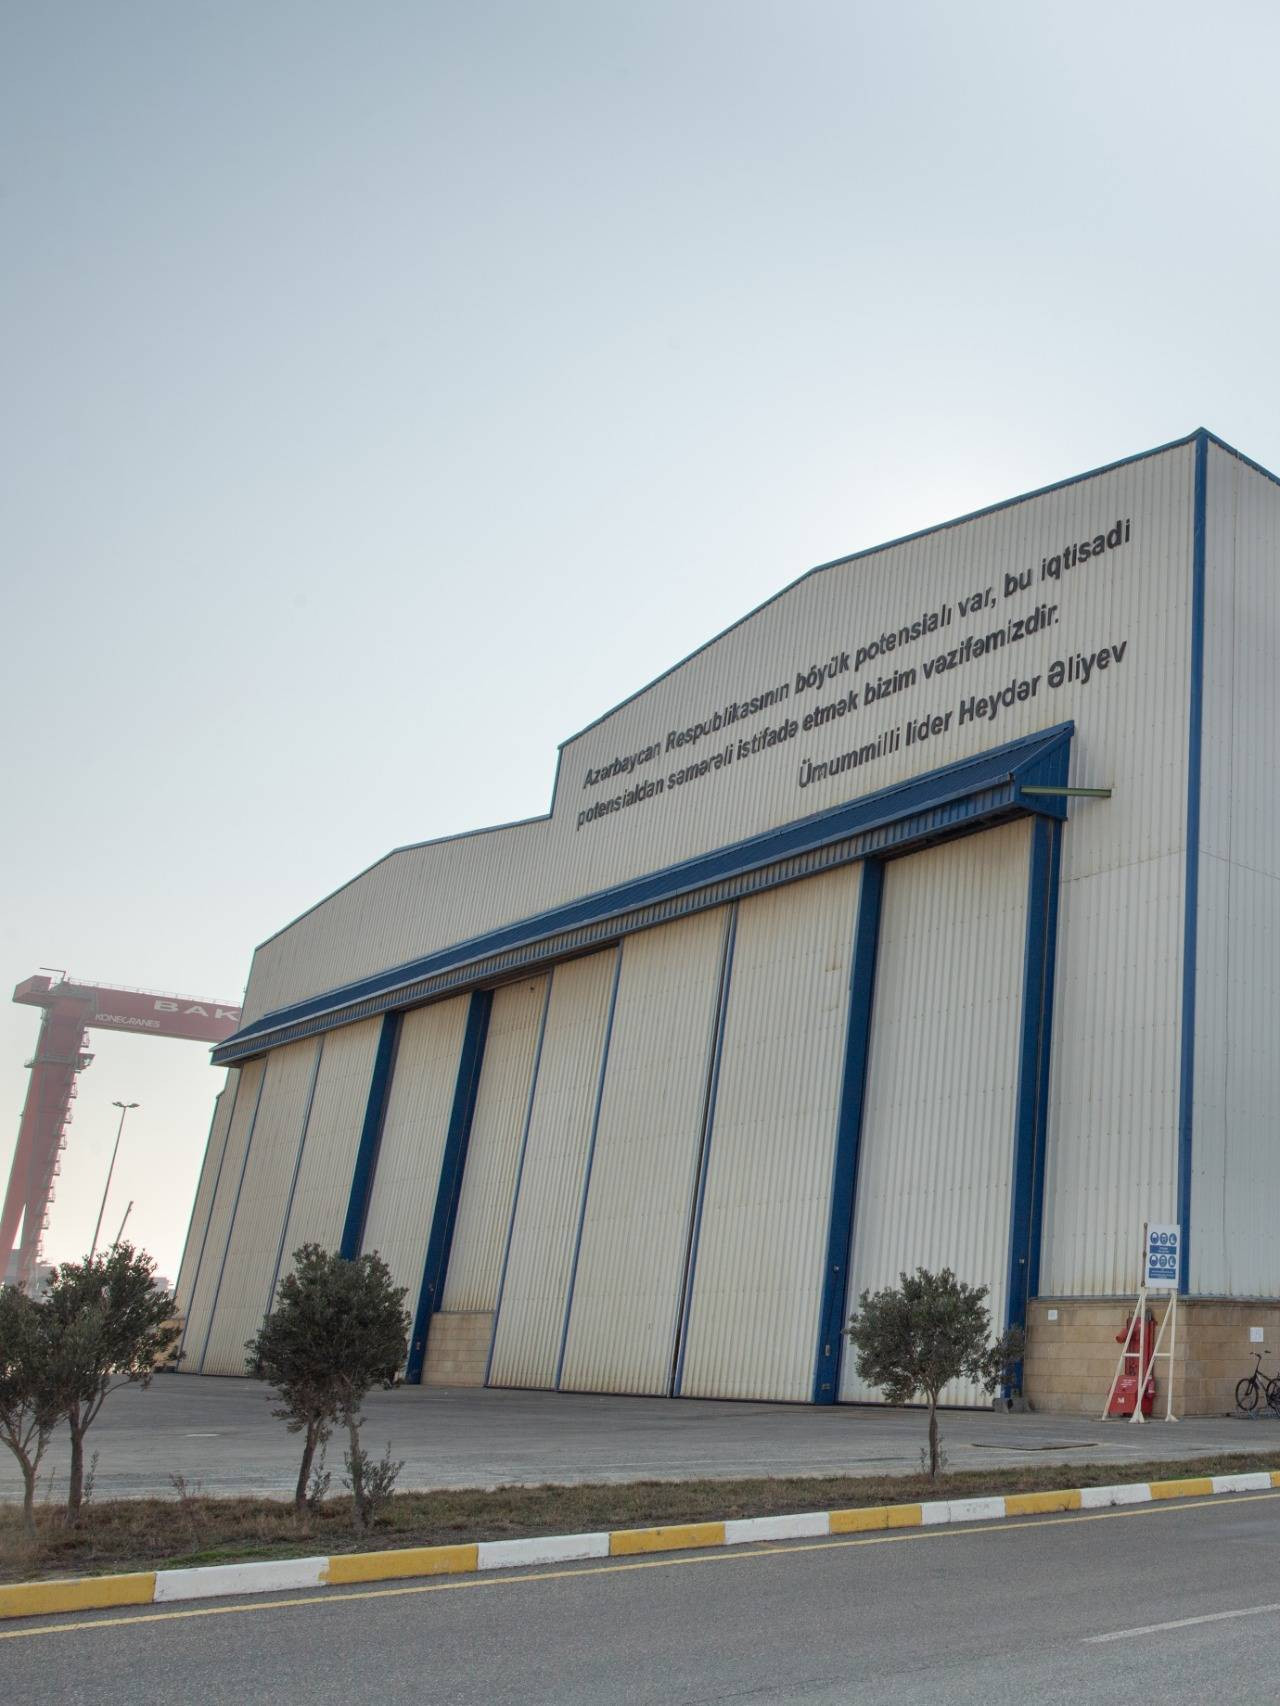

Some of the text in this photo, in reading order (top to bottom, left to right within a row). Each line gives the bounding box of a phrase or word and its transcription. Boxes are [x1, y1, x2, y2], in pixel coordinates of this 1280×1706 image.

[795, 652, 851, 695] böyük
[854, 604, 952, 672] potensialı
[957, 587, 997, 617] var,
[1004, 568, 1032, 598] bu
[1041, 518, 1131, 581] iqtisadi
[577, 777, 664, 831] potensialdan
[667, 744, 733, 790] səmərəli
[736, 719, 799, 761] istifadə
[802, 690, 859, 732] etmək
[863, 667, 917, 706] bizim
[798, 641, 1128, 789] Ümummilli lider Heydər Əliyev
